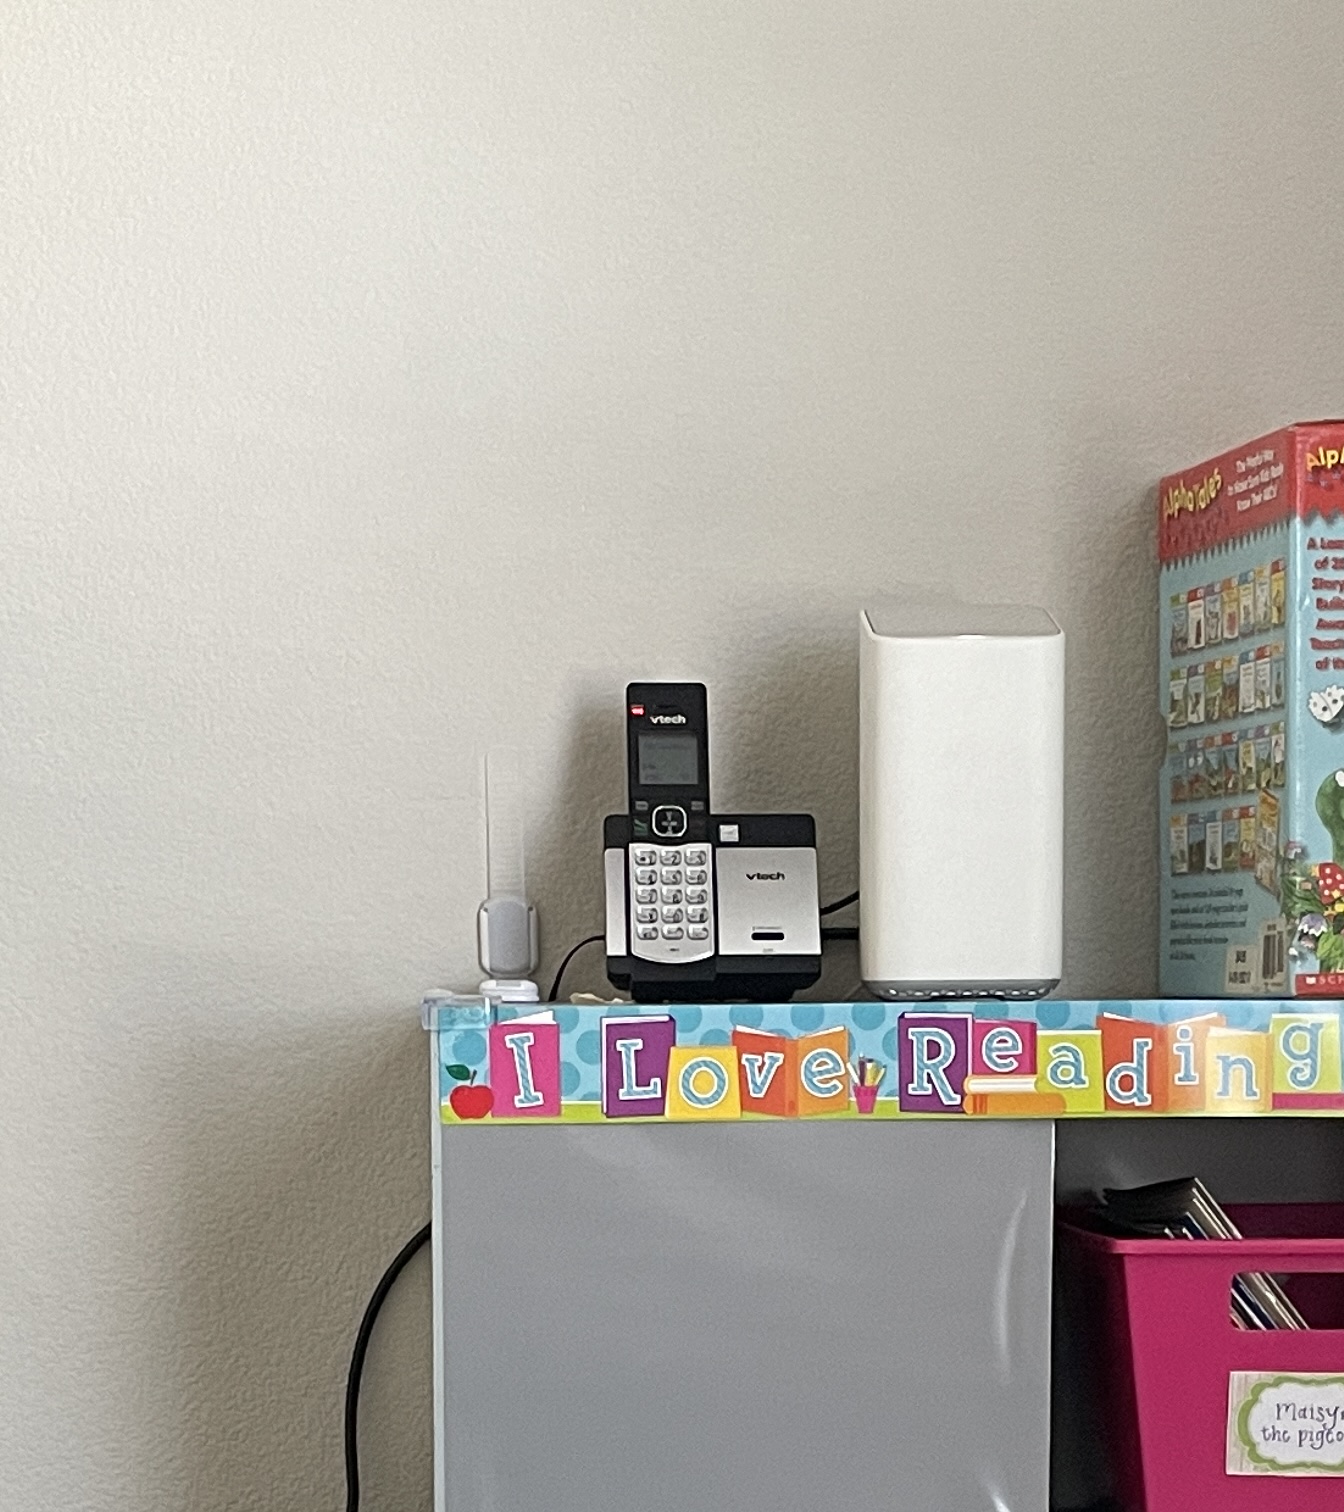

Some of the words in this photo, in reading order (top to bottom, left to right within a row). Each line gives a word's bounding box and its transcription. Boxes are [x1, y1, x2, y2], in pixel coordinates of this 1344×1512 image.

[1162, 467, 1223, 522] AlphaTales
[650, 714, 687, 725] vtech
[746, 870, 786, 882] vtech
[503, 1033, 544, 1108] I
[617, 1036, 848, 1110] Love
[907, 1016, 1324, 1108] Reading
[1276, 1402, 1340, 1430] Maisy
[1260, 1424, 1291, 1442] the
